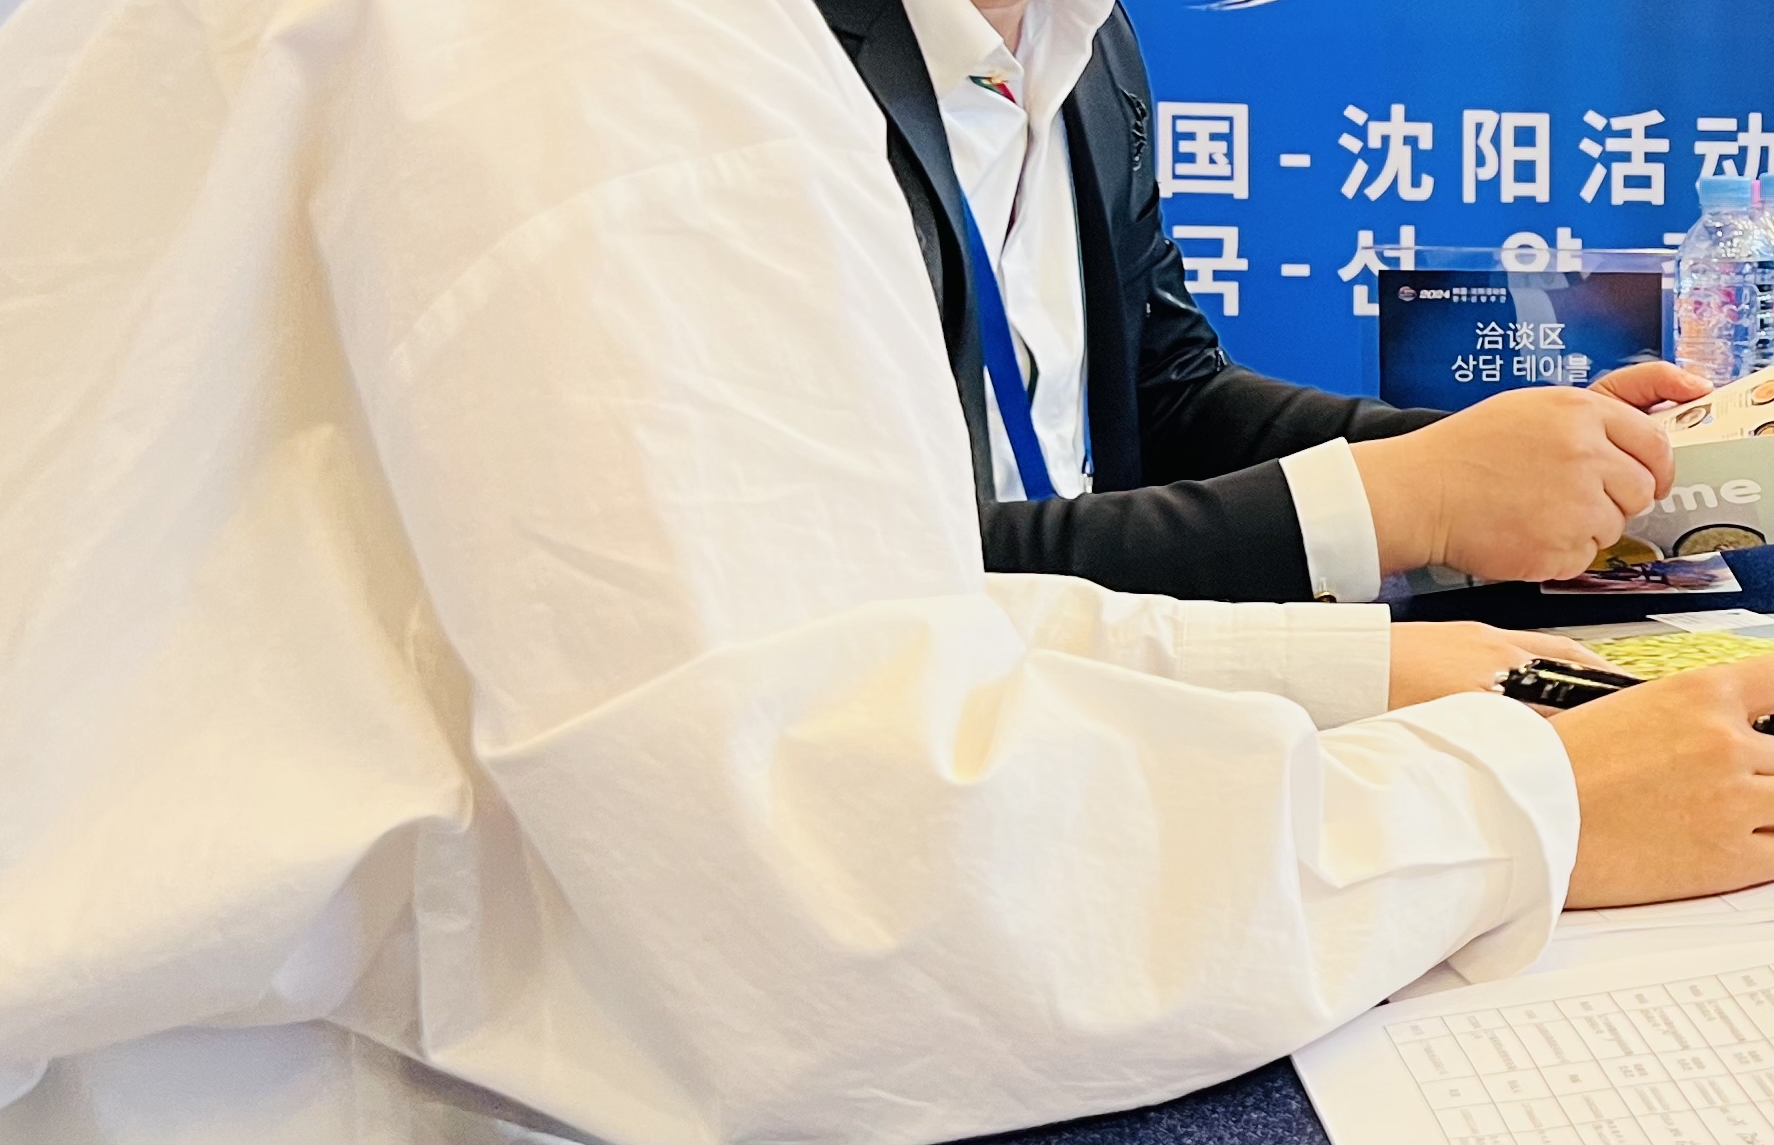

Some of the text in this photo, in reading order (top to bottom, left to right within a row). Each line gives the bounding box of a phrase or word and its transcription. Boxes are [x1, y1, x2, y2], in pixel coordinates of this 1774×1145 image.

[1475, 321, 1566, 351] 洽谈区
[1451, 355, 1592, 383] 상담 테이블
